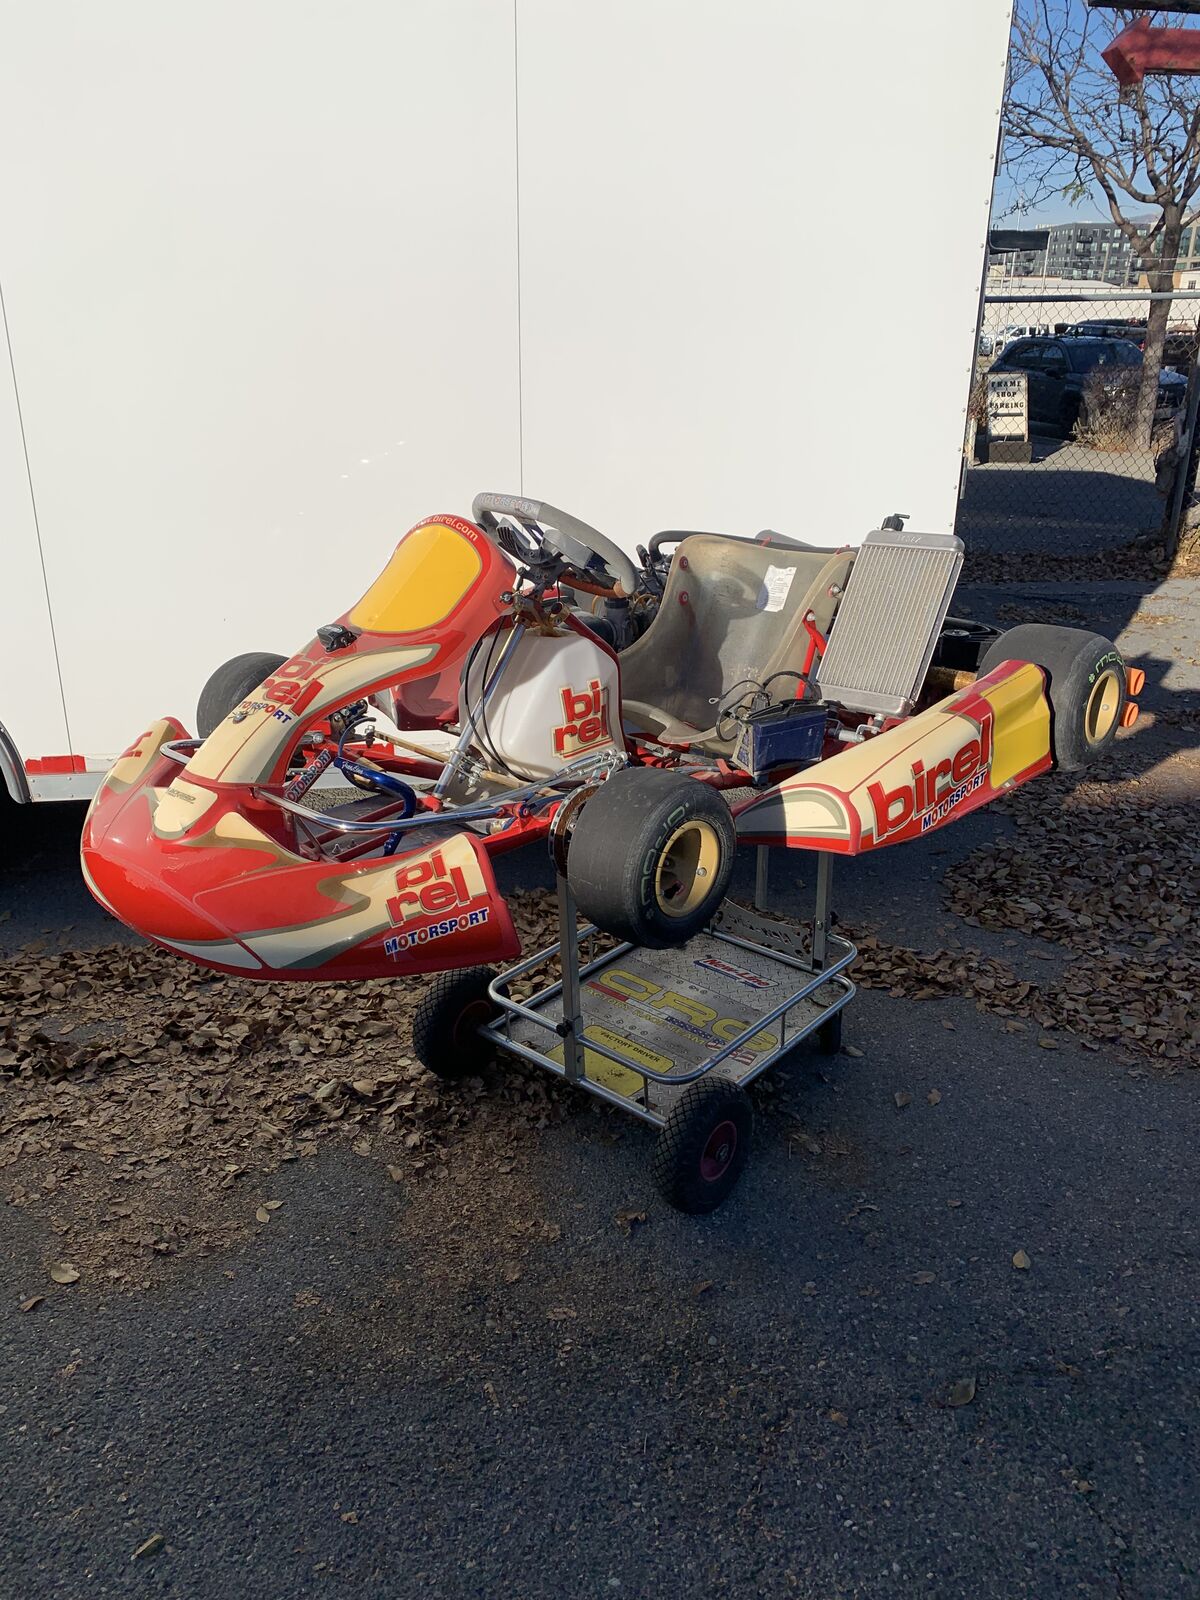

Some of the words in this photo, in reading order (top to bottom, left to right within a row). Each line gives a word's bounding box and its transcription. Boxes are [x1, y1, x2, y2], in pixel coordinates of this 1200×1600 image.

[990, 401, 1024, 409] PARKING
[991, 380, 1022, 388] FRAME
[562, 680, 601, 723] bi
[554, 703, 609, 754] rel
[284, 749, 331, 803] OTORSPORT
[867, 715, 992, 840] birel
[921, 771, 987, 831] MOTORSPORT
[385, 866, 471, 925] rel
[384, 907, 489, 955] MOTORSPORT
[704, 959, 770, 987] New-Line
[599, 968, 779, 1052] CRG
[600, 1031, 632, 1050] FACTORY
[632, 1046, 661, 1063] DRIVER
